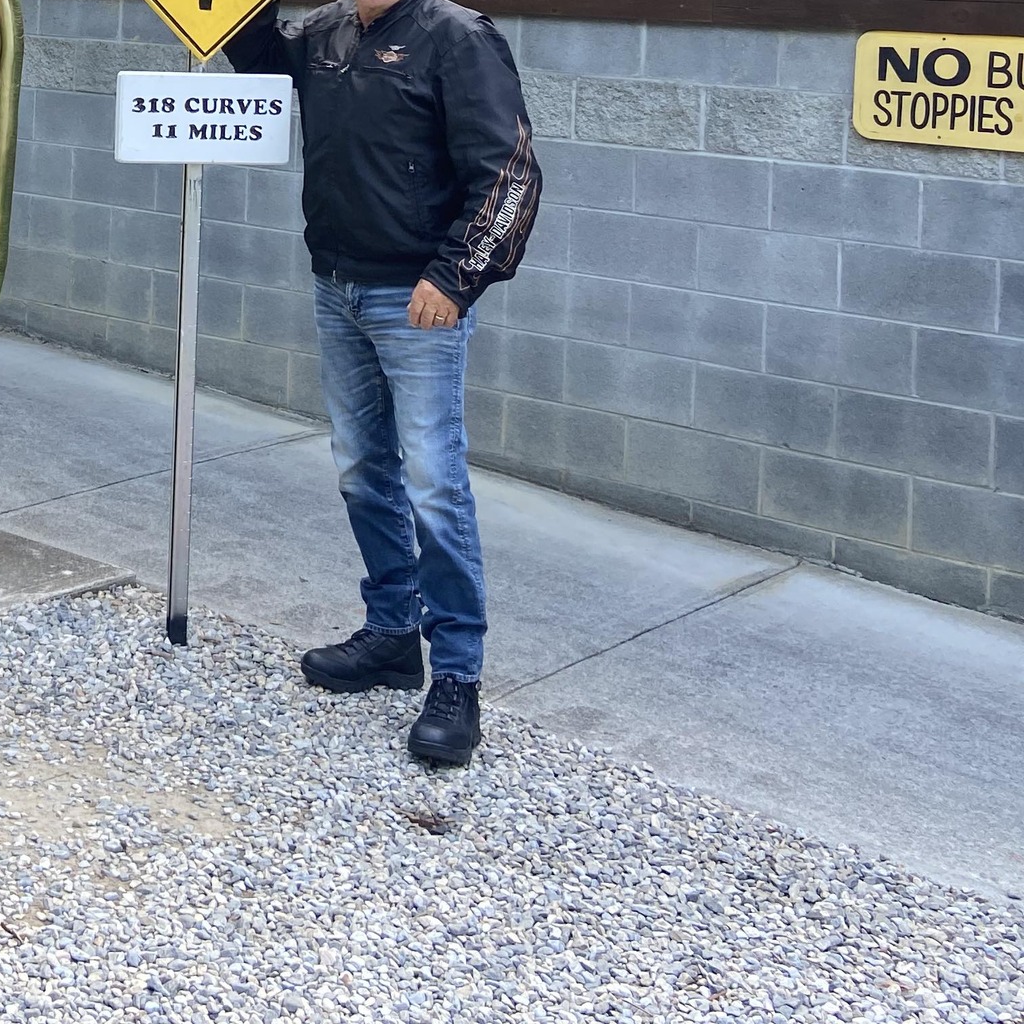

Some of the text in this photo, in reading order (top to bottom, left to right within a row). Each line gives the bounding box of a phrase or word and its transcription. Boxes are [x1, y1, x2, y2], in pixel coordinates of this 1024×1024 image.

[878, 46, 971, 87] NO
[131, 97, 283, 115] 318 CURVES
[873, 89, 1014, 136] STOPPIES
[152, 123, 263, 141] 11 MILES
[468, 181, 526, 272] HALEY-DAVIDSON
